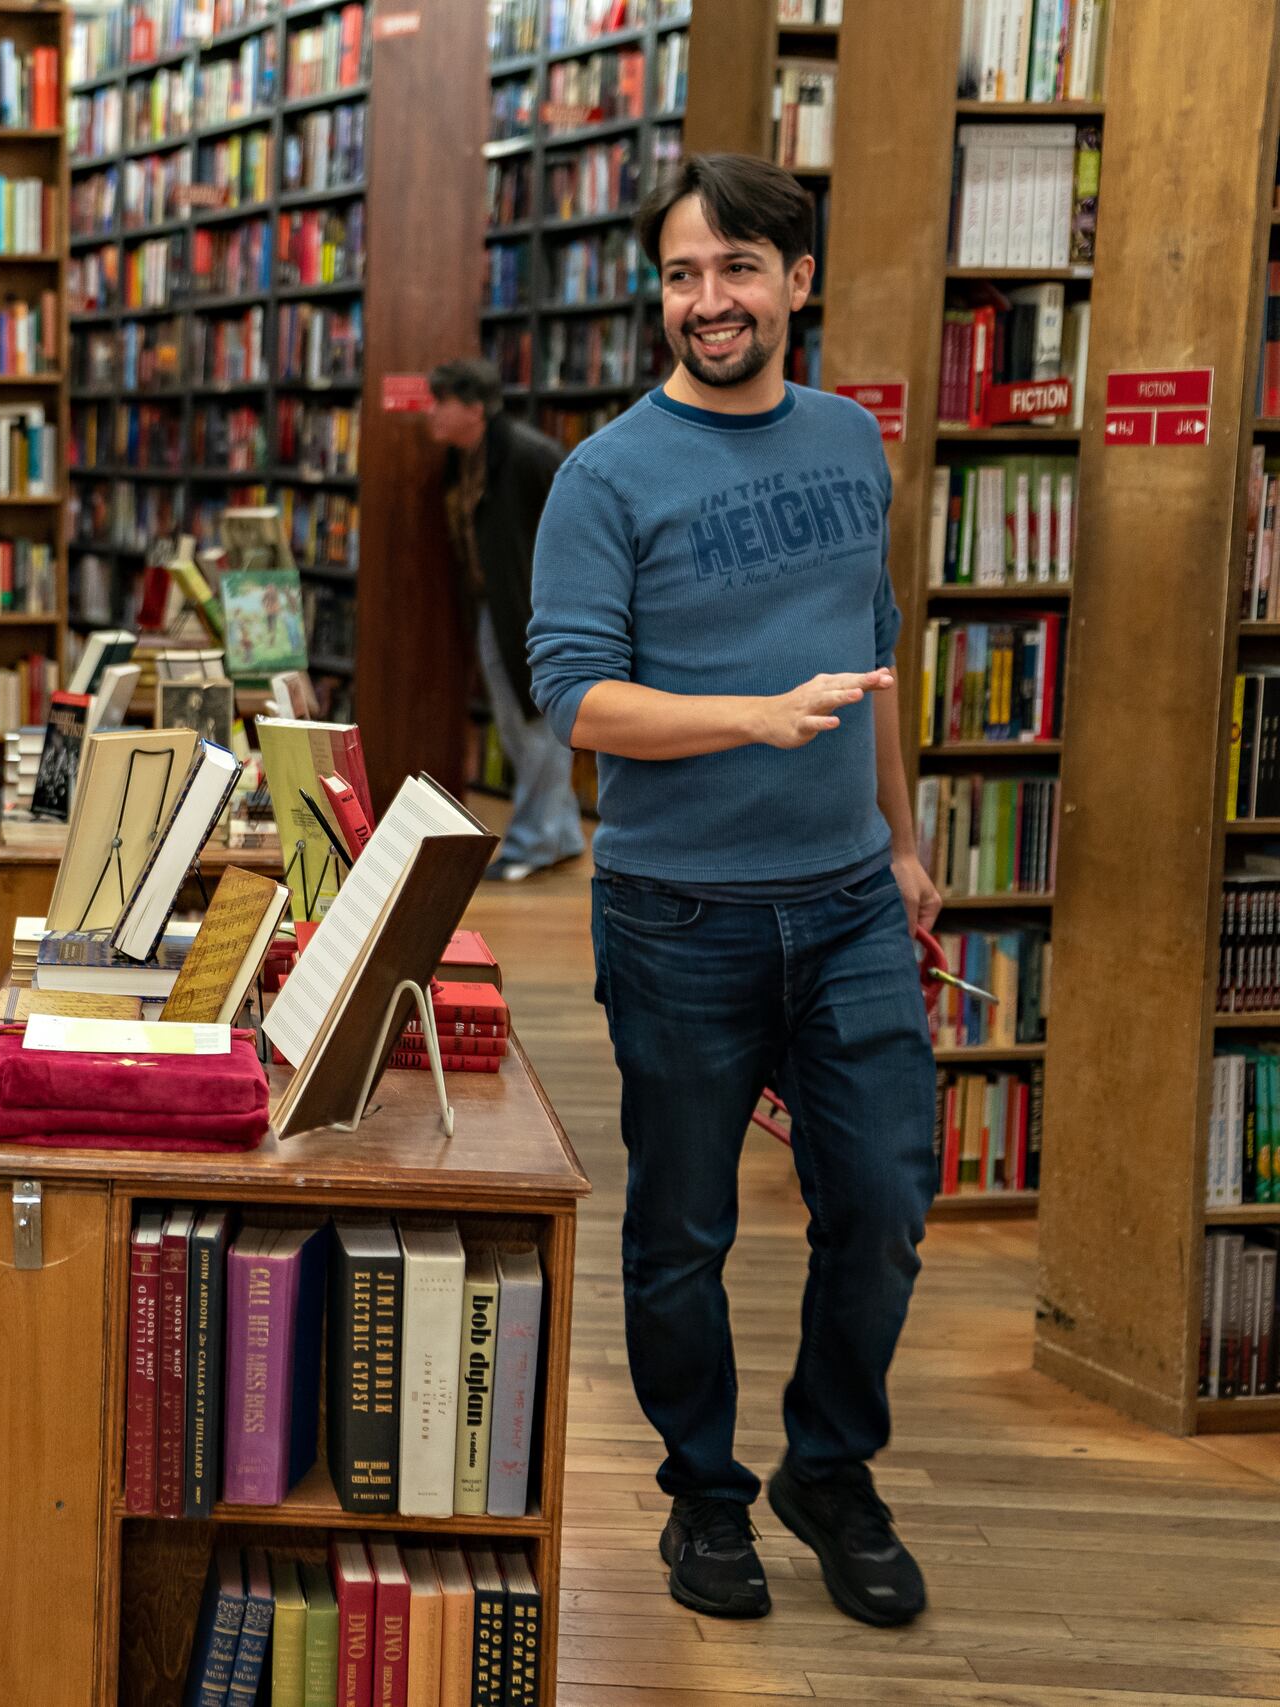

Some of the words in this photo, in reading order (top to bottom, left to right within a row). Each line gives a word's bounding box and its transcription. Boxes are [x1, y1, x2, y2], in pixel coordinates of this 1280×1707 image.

[1010, 384, 1069, 415] FICTION
[1138, 380, 1176, 398] FICTION
[1119, 419, 1135, 436] H-J
[1175, 418, 1194, 436] J-K
[699, 490, 728, 514] IN
[734, 472, 785, 501] THE
[688, 478, 880, 582] HEIGHTS
[741, 569, 771, 587] New
[198, 1248, 210, 1280] JOHN
[198, 1284, 208, 1330] ARDOIN
[248, 1268, 270, 1310] CALL
[376, 1272, 396, 1318] JIMI
[136, 1284, 148, 1376] JUILLIARD
[146, 1298, 156, 1344] ARDOIN
[162, 1280, 174, 1374] JUILLIARD
[174, 1294, 184, 1340] ARDOIN
[246, 1314, 270, 1348] HER
[352, 1272, 370, 1352] ELECTRIC
[470, 1296, 494, 1346] bob
[1244, 1302, 1254, 1338] KANON
[1262, 1300, 1272, 1338] KANON
[146, 1352, 156, 1382] JOHN
[174, 1348, 182, 1378] JOHN
[196, 1350, 206, 1396] CALLAS
[246, 1352, 268, 1390] MISS
[374, 1324, 394, 1416] HENDRIX
[422, 1352, 432, 1386] JOHN
[516, 1352, 528, 1380] TELL
[134, 1392, 144, 1412] AT
[162, 1390, 172, 1410] AT
[196, 1398, 204, 1416] AT
[352, 1362, 370, 1414] GYPSY
[436, 1378, 448, 1418] LIVES
[464, 1352, 490, 1428] dylan
[514, 1390, 526, 1410] ME
[244, 1392, 266, 1434] ROSS
[420, 1392, 432, 1442] LENNON
[512, 1416, 524, 1450] WHY
[132, 1430, 144, 1510] CALLAS
[160, 1428, 172, 1508] CALLAS
[194, 1418, 204, 1480] JUILLIARD
[468, 1432, 478, 1470] scaduto
[348, 1614, 368, 1660] DIVO
[384, 1616, 404, 1662] DIVO
[478, 1602, 490, 1694] MICHAEL
[490, 1604, 504, 1702] MOONWAL
[510, 1604, 524, 1698] MICHAEL
[524, 1606, 538, 1706] MOONWAL
[206, 1669, 230, 1680] MUSIC
[233, 1671, 257, 1681] MUSIC
[346, 1662, 358, 1698] HELENA
[382, 1664, 394, 1702] HELENA
